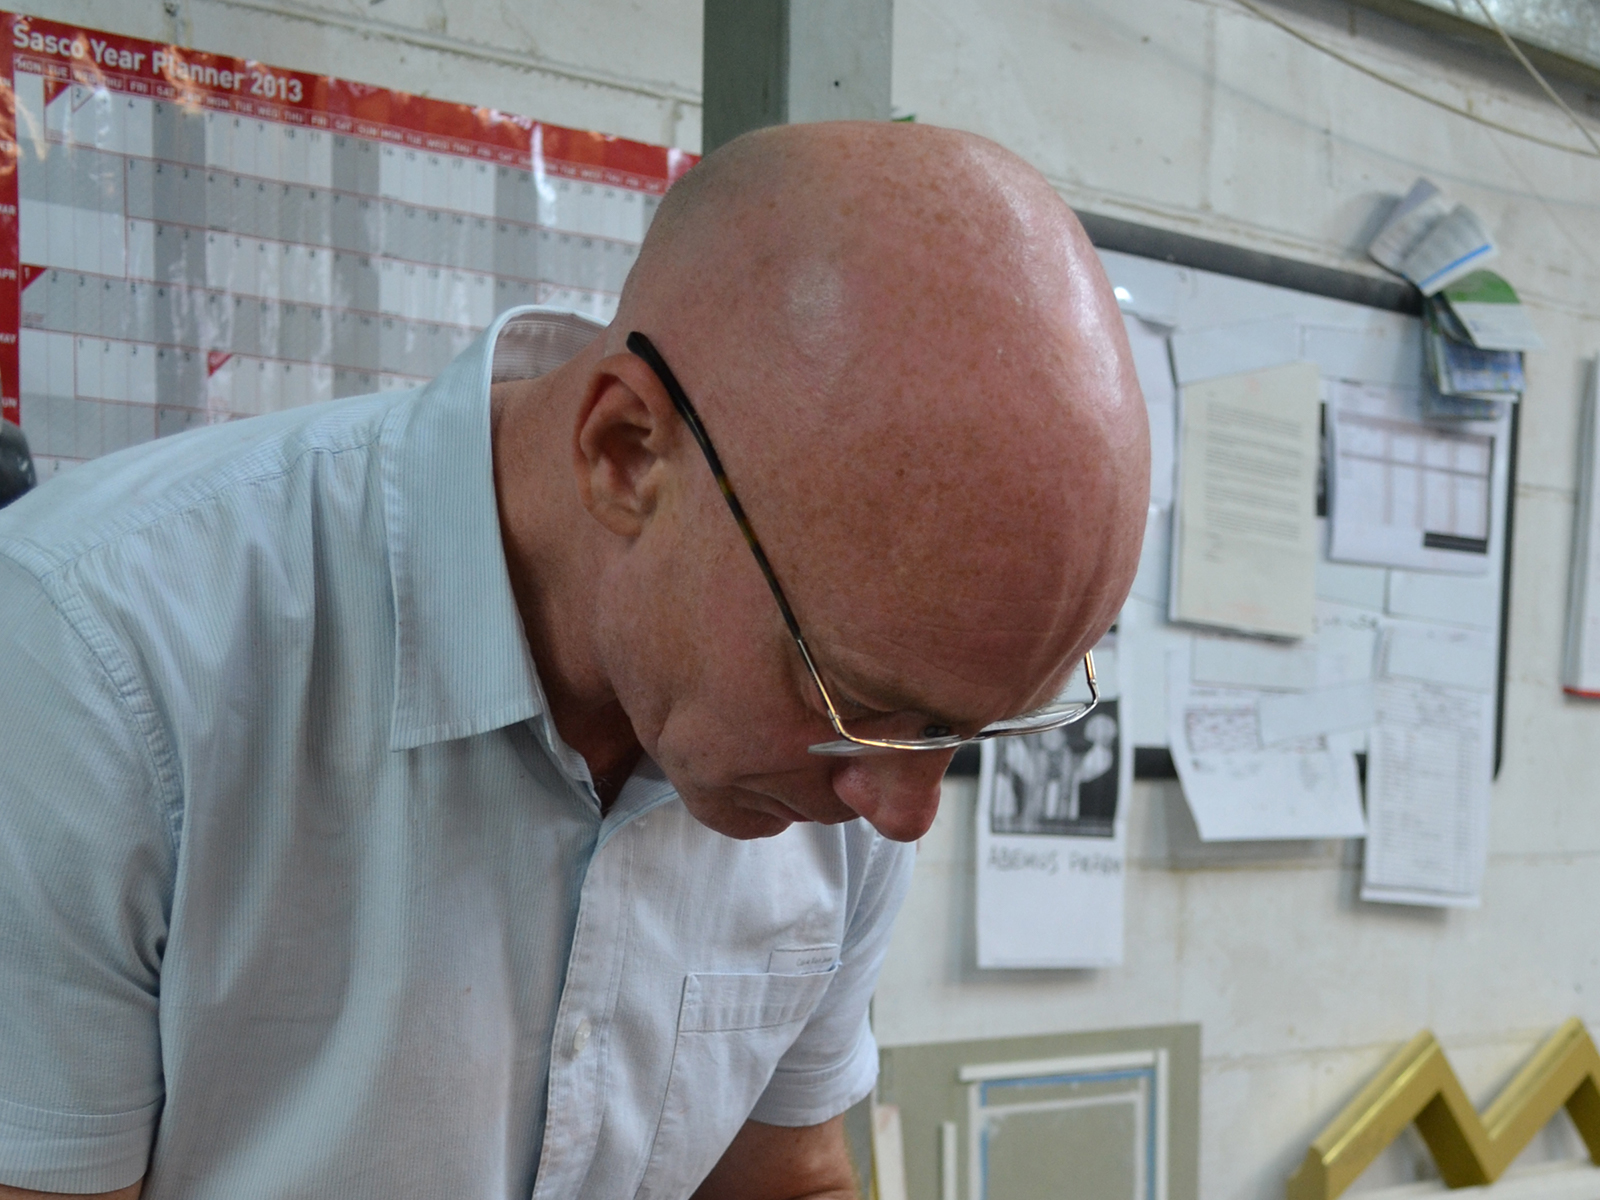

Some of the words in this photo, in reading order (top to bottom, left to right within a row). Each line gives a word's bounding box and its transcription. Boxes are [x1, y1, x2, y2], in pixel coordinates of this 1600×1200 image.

[13, 22, 84, 59] Sasco
[90, 38, 146, 71] Year
[152, 50, 245, 91] Planner
[250, 70, 303, 103] 2013
[18, 58, 42, 72] MON
[48, 64, 69, 79] TUE
[129, 81, 148, 93] FRI
[156, 85, 176, 98] SAT
[235, 101, 253, 113] TUE
[258, 106, 279, 118] WED
[311, 114, 327, 126] FRI
